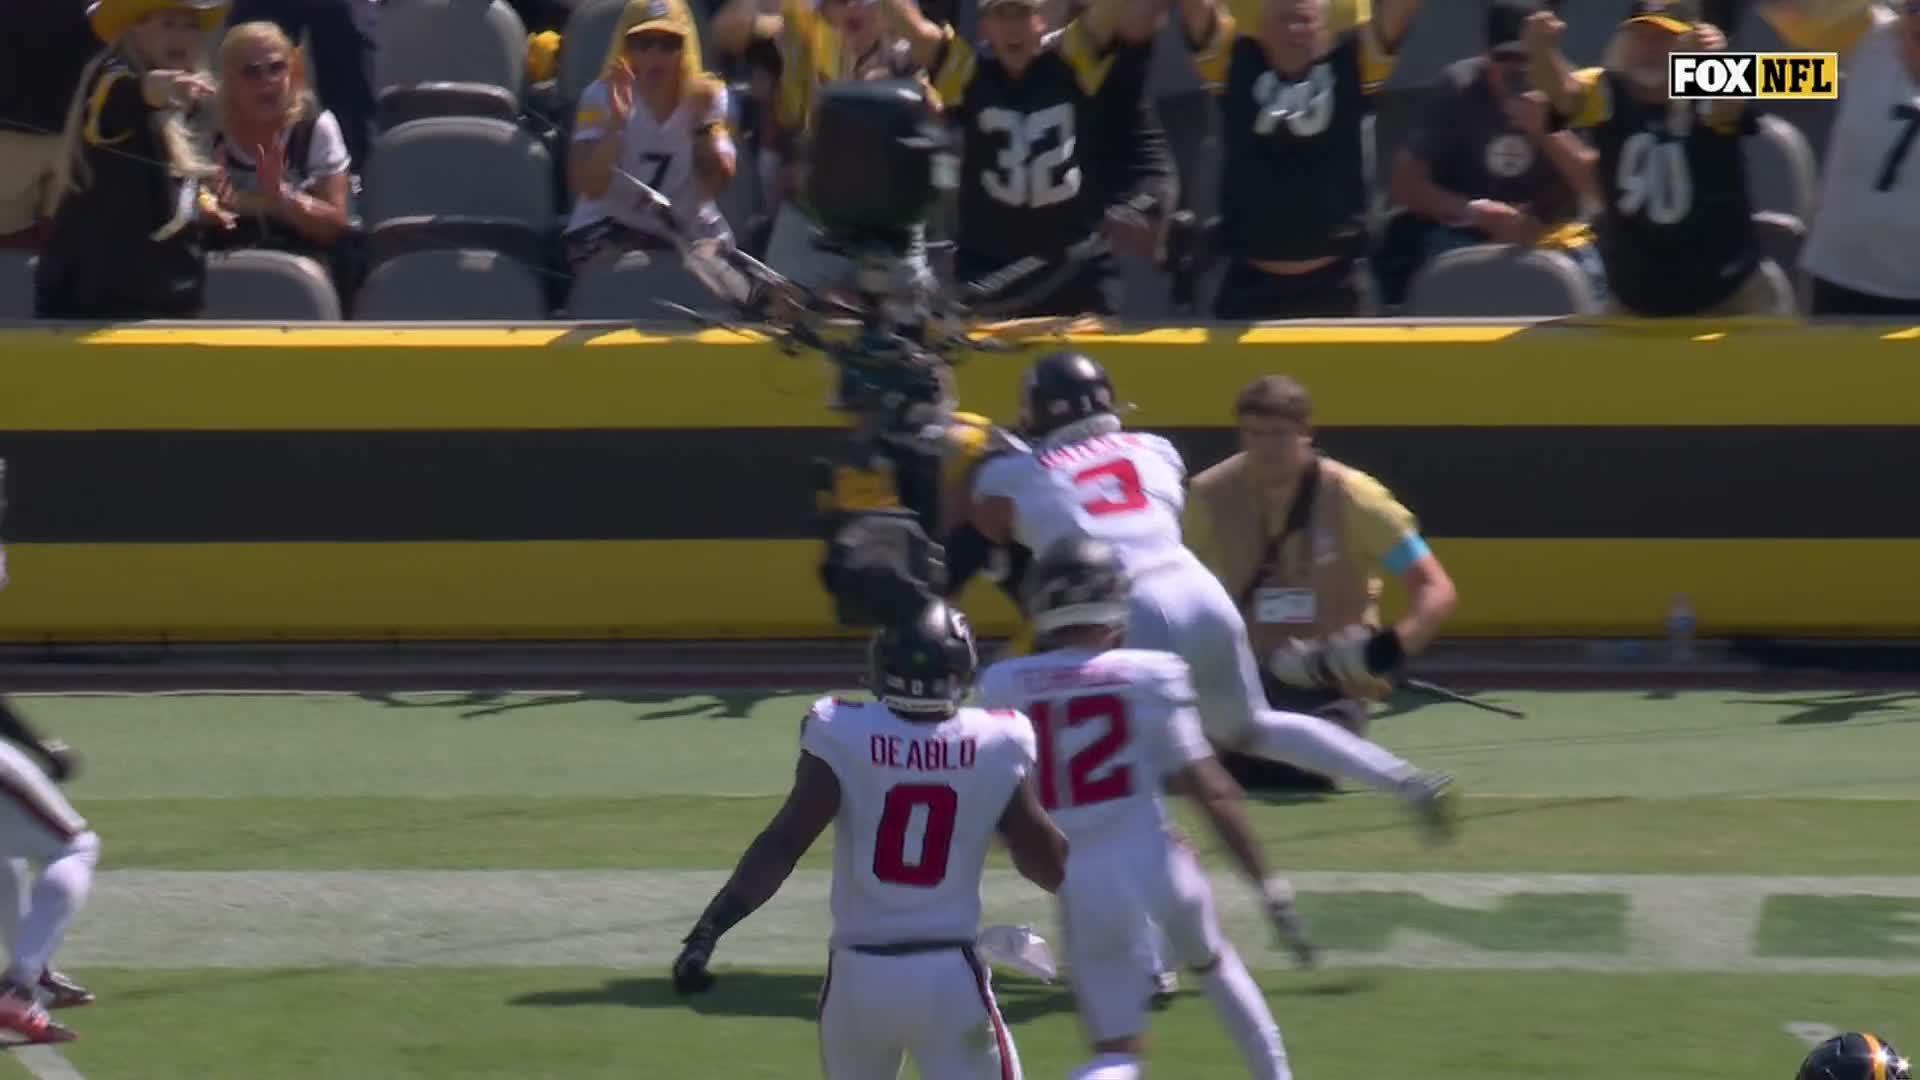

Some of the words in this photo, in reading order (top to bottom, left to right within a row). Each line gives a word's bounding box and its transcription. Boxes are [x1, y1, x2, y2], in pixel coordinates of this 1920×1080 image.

[640, 152, 673, 191] 7
[978, 102, 1082, 208] 32
[1616, 132, 1694, 224] 90
[1073, 457, 1147, 516] 3
[870, 735, 977, 770] DEABLO
[1031, 694, 1136, 811] 12
[872, 782, 959, 888] 0
